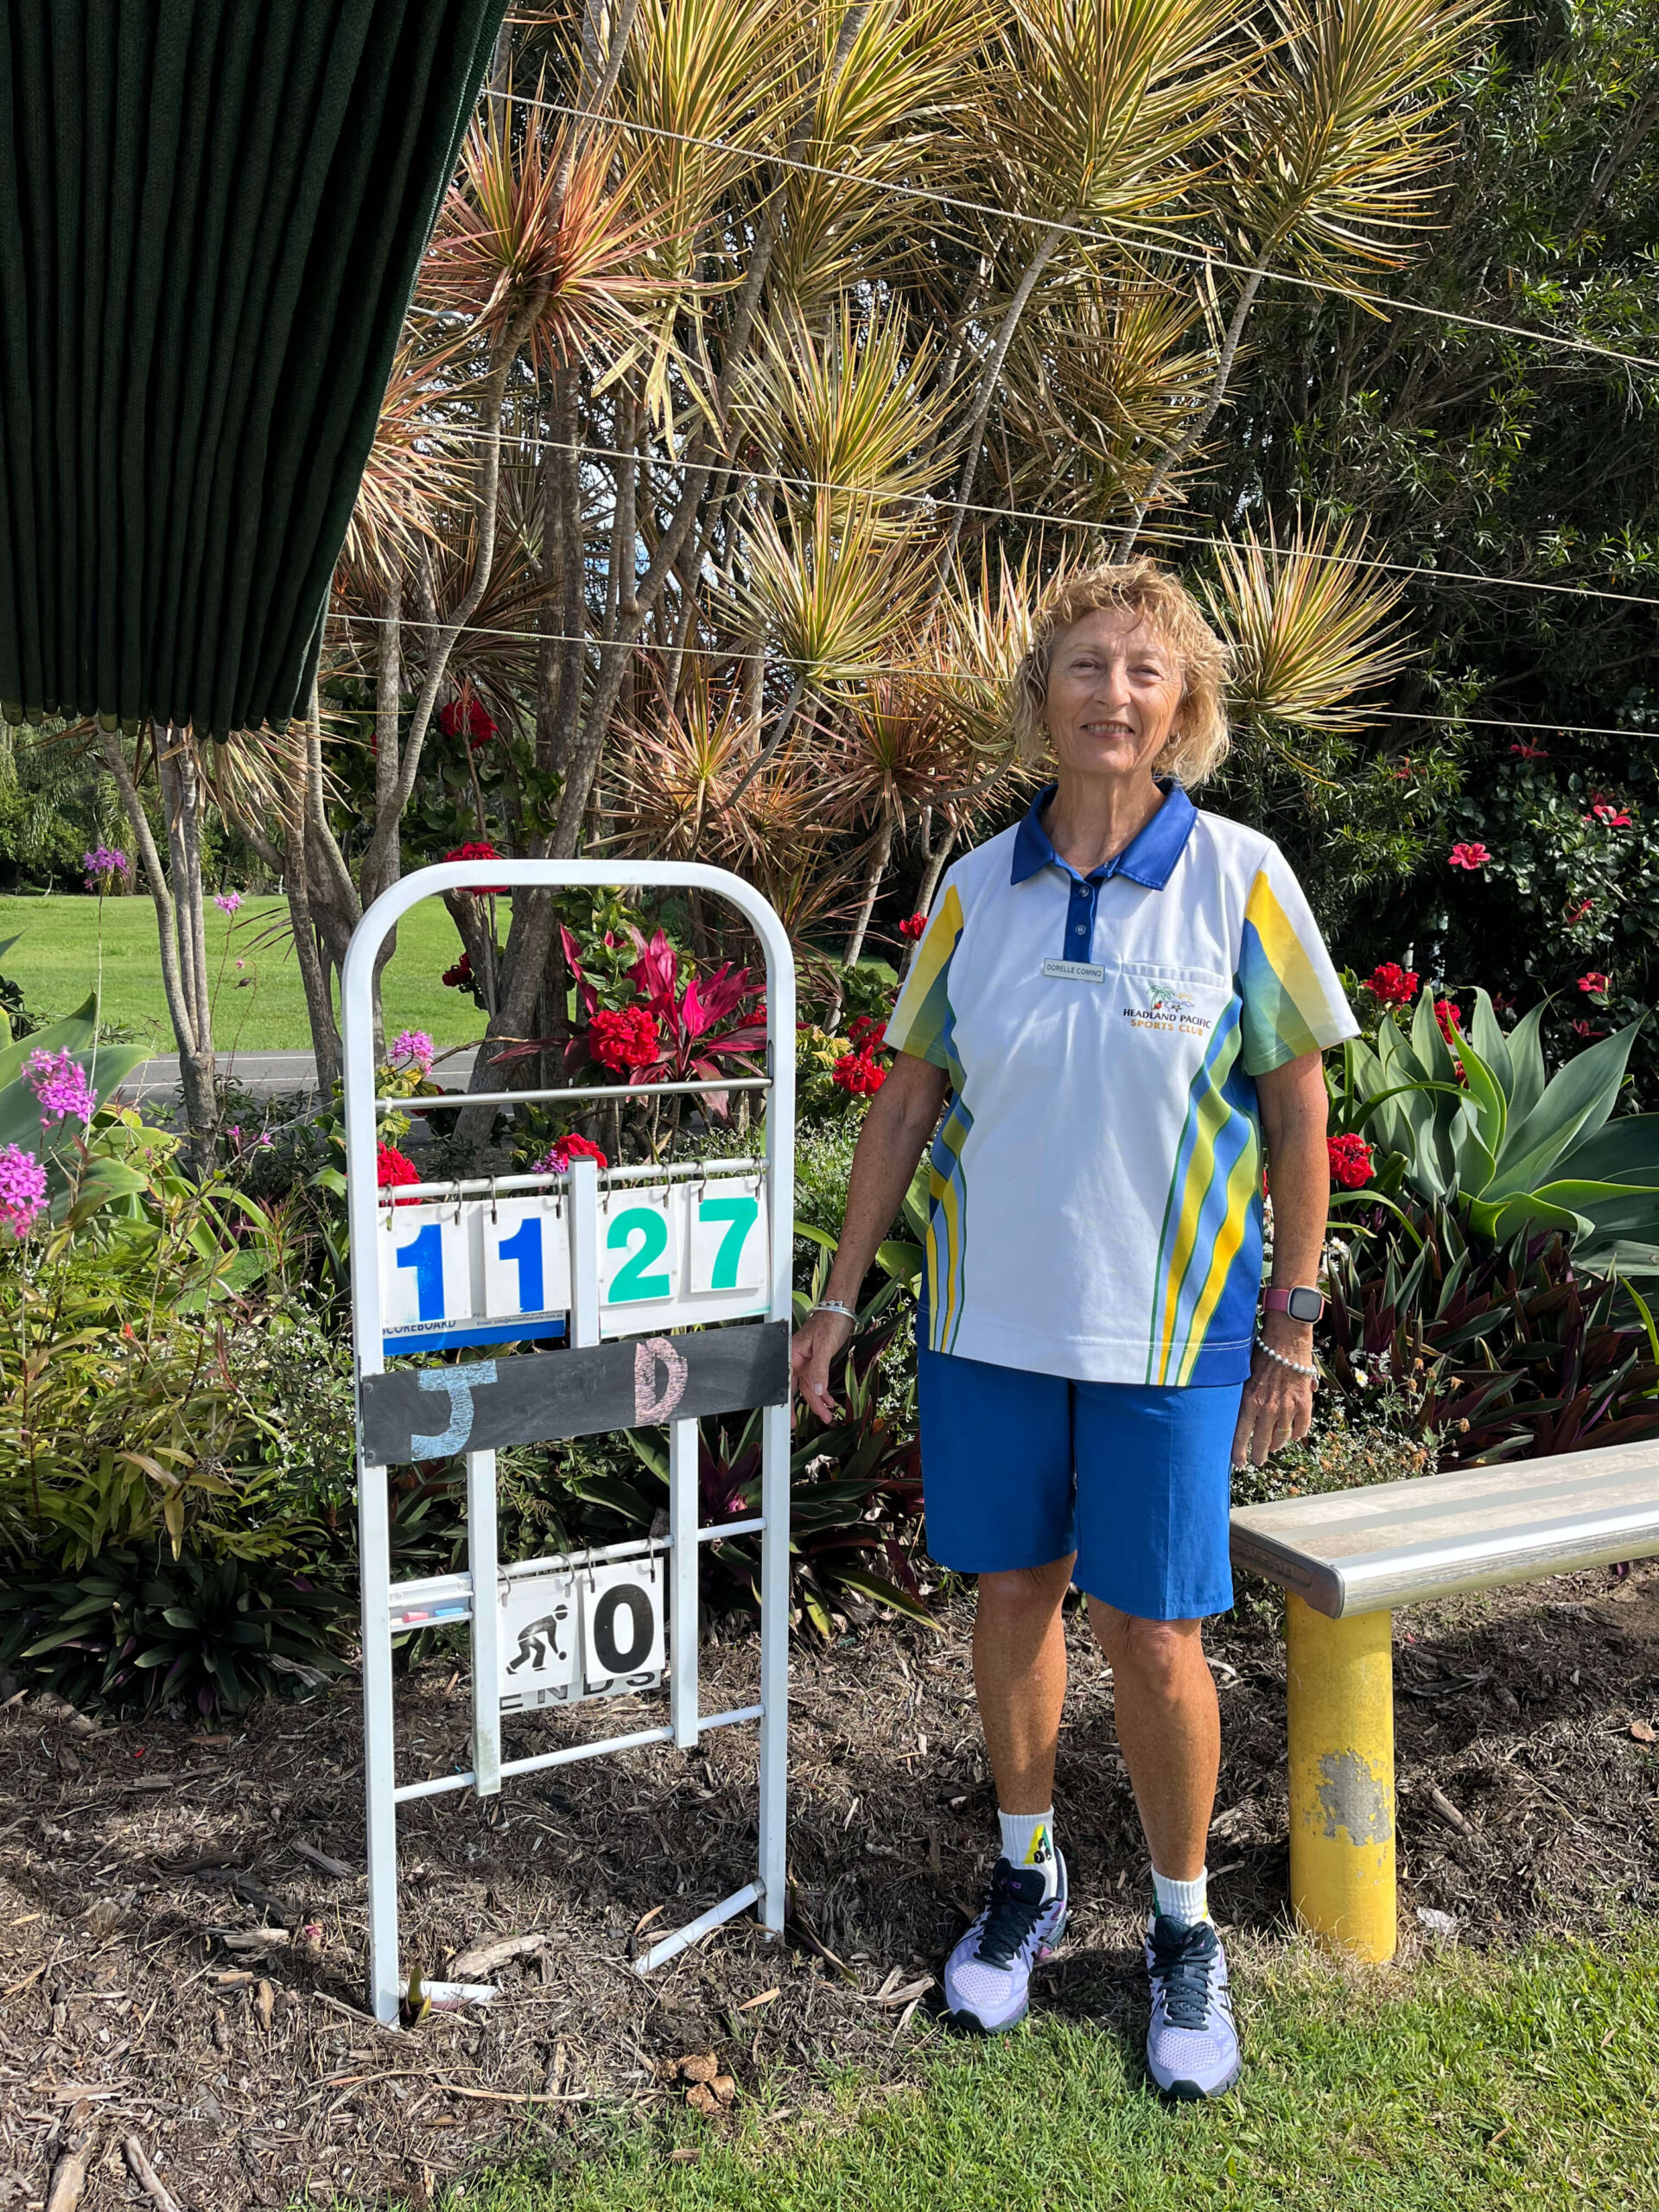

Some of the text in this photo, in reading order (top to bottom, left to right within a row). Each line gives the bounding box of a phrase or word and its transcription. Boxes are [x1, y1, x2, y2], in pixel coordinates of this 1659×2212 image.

[1046, 963, 1102, 977] DORELLE COMINO
[1123, 1008, 1211, 1029] HEADLAND PACIFIC
[1130, 1018, 1204, 1037] SPORTS CLUB
[410, 1337, 689, 1462] J D
[594, 1583, 655, 1674] 0
